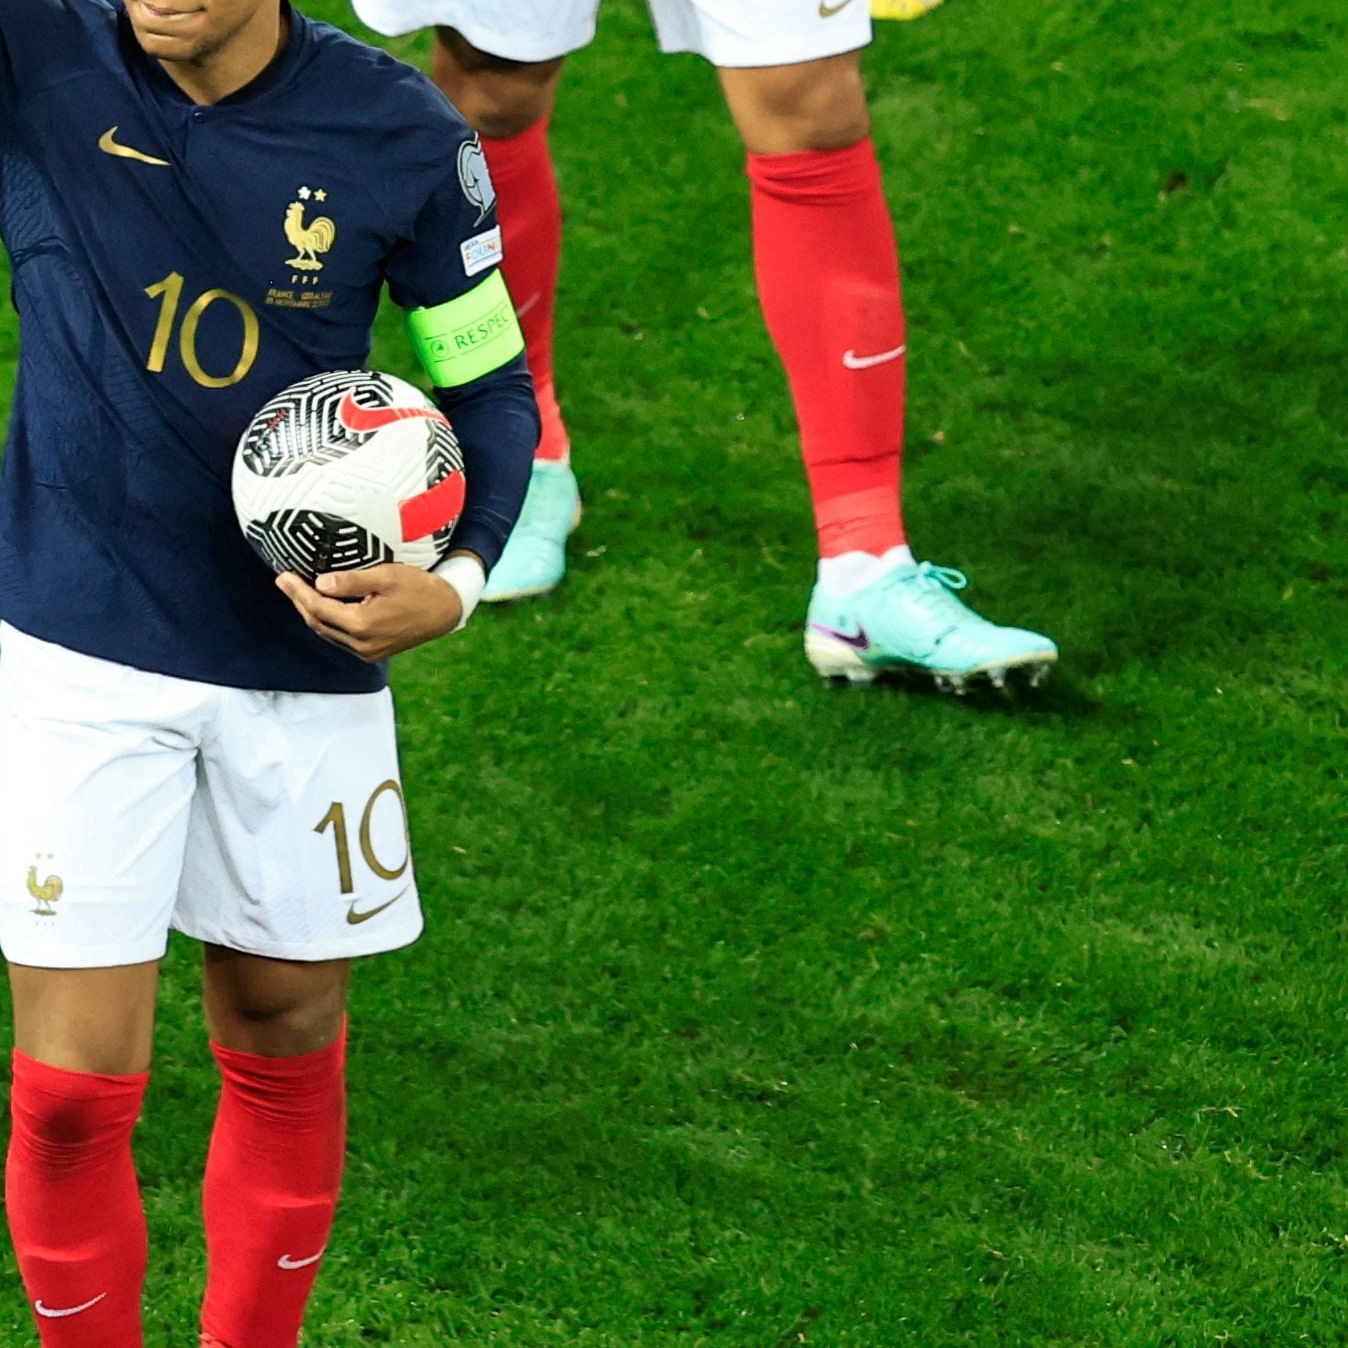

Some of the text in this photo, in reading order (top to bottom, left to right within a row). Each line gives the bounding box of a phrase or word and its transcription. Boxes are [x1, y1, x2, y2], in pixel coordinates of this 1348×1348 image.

[144, 271, 260, 388] 10
[454, 302, 511, 350] RESPEC
[312, 778, 409, 894] 10
